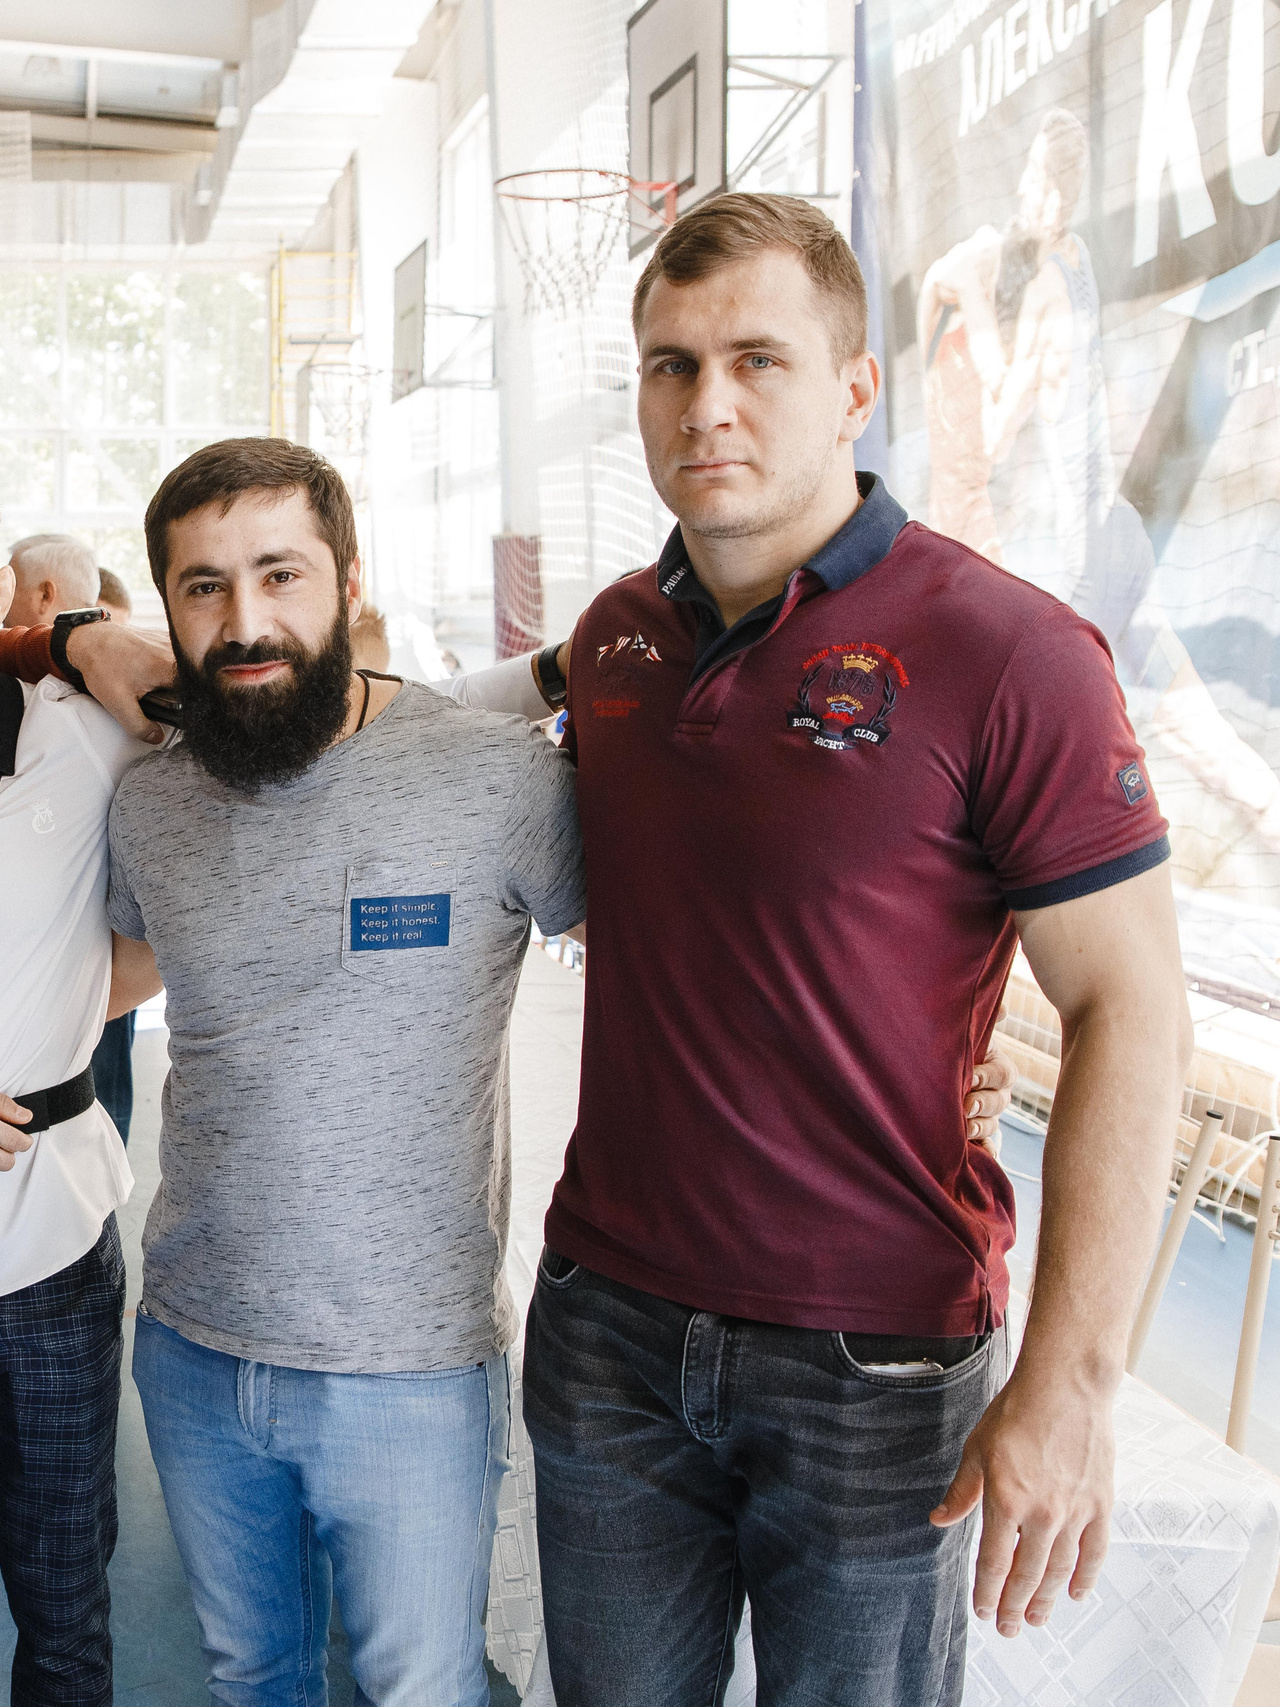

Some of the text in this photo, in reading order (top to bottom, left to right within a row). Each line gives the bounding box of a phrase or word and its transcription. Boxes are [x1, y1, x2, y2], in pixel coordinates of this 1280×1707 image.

[792, 717, 821, 731] ROYAL
[853, 728, 880, 743] CLUB
[814, 735, 845, 750] YACHT
[360, 904, 388, 915] Keep
[391, 903, 399, 913] it
[361, 916, 440, 929] Keep it honest.
[361, 932, 389, 943] Keep
[392, 932, 400, 940] it
